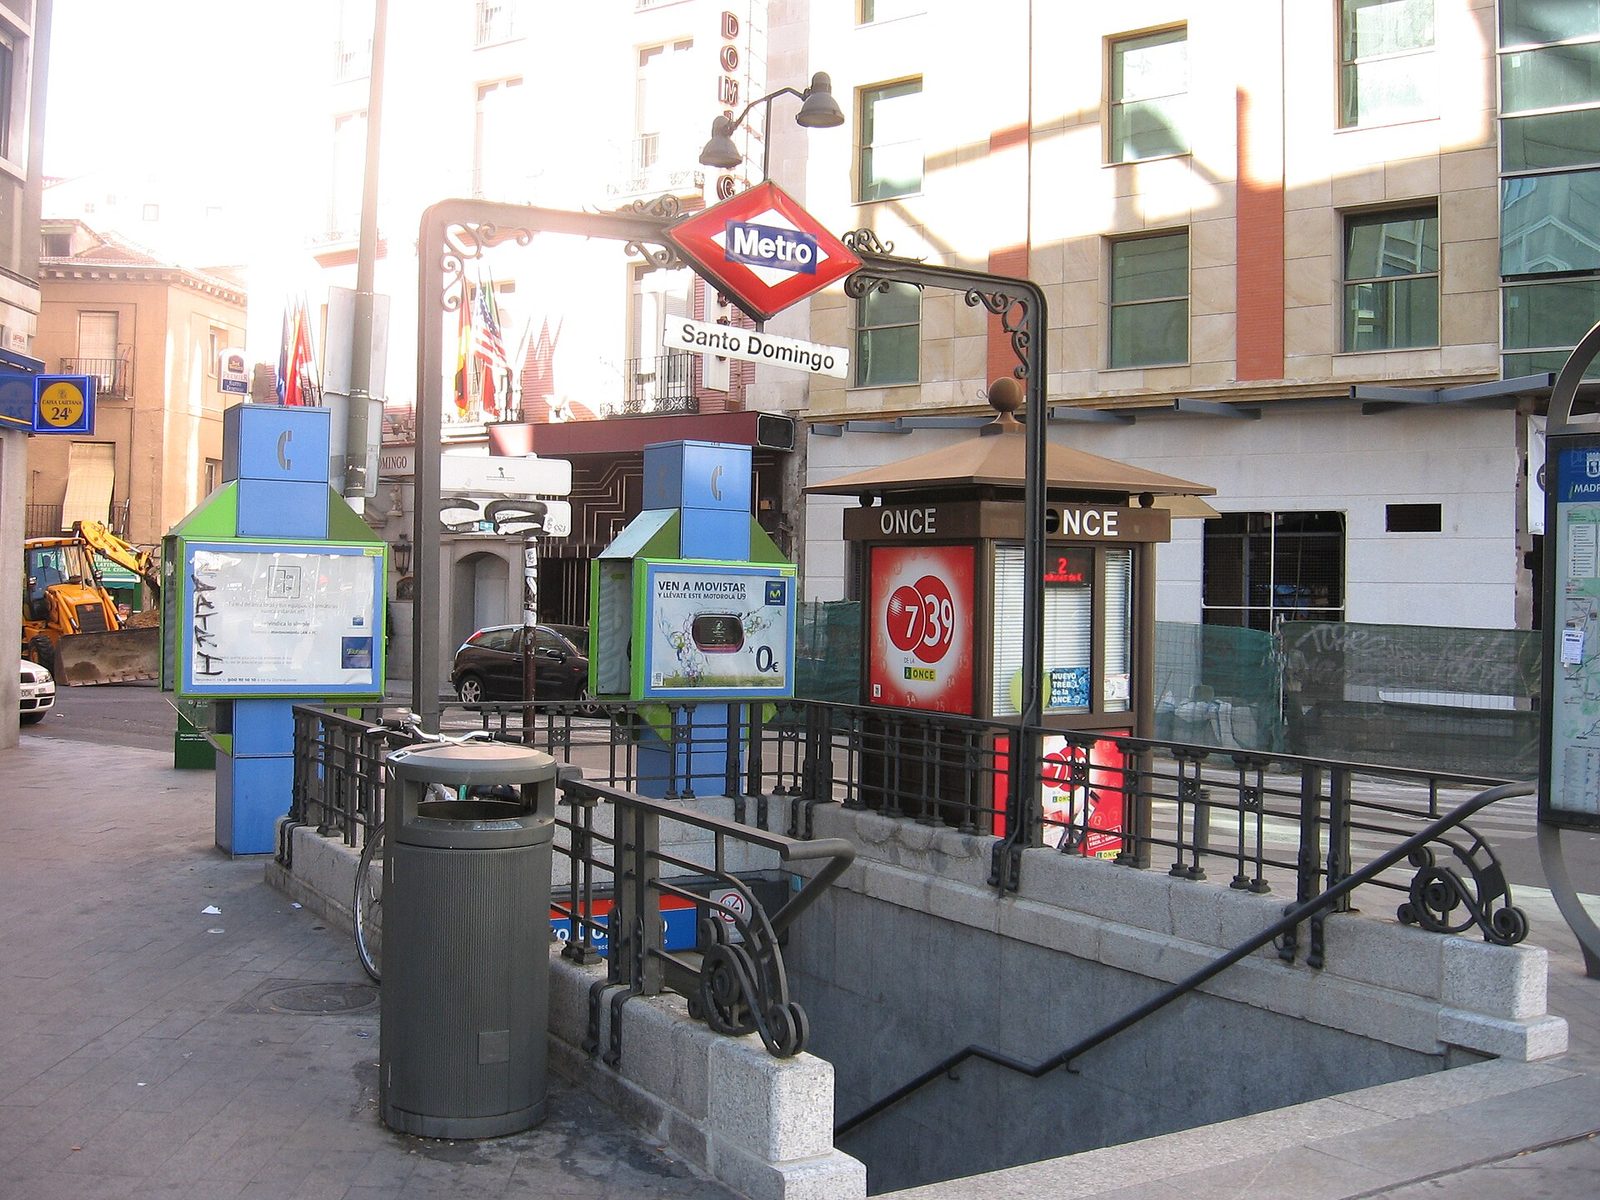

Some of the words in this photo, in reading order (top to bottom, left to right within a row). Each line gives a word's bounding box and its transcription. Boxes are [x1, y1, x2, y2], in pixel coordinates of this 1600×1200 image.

[734, 227, 812, 264] Metro
[682, 324, 741, 351] Santo
[748, 336, 835, 371] Domingo
[880, 508, 936, 535] ONCE
[1058, 557, 1068, 574] 2
[658, 581, 679, 591] VEN
[683, 582, 691, 591] A
[694, 582, 746, 593] MOVISTAR
[905, 605, 919, 638] 7
[923, 594, 954, 646] 39
[912, 671, 934, 680] ONCE
[1052, 672, 1077, 680] NUEVO
[1051, 696, 1072, 704] ONCE
[1052, 764, 1063, 779] 7
